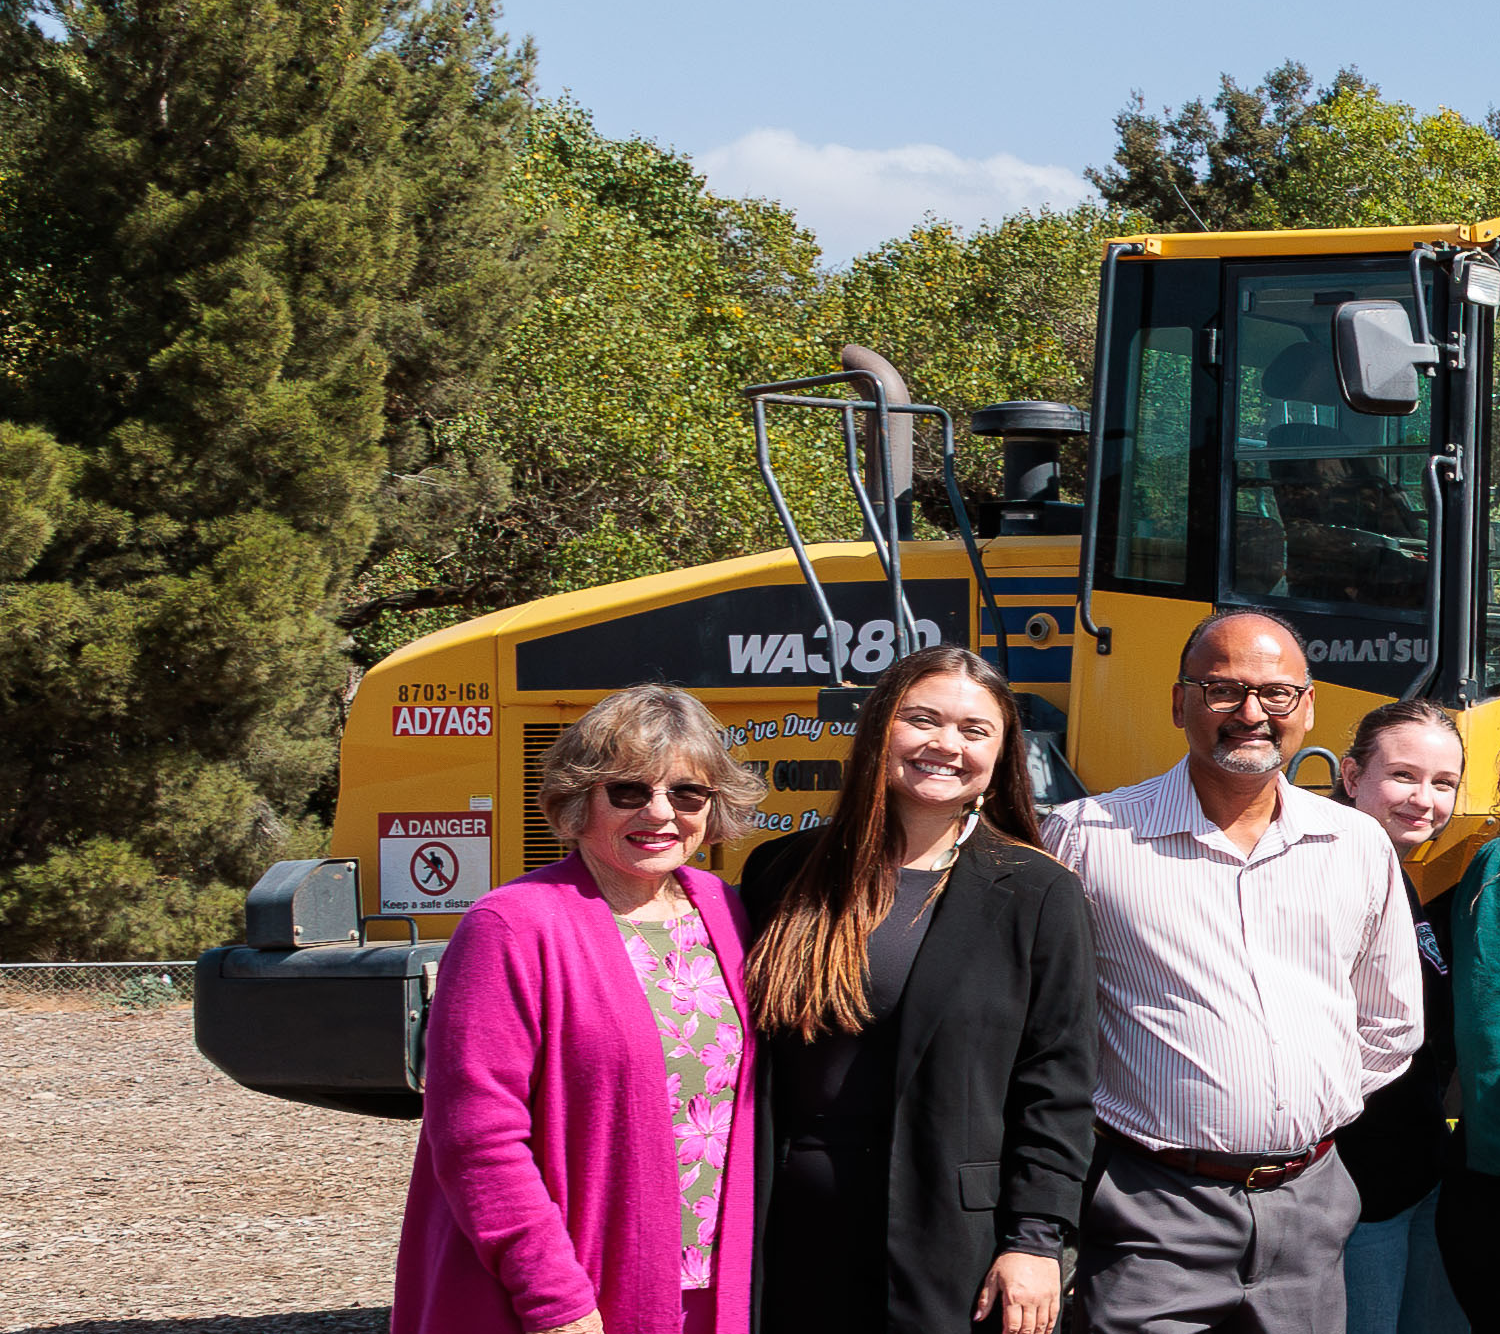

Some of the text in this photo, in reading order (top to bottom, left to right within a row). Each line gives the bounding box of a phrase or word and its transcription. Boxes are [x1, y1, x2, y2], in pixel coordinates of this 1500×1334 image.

[1303, 632, 1429, 663] OMATSU
[398, 682, 490, 702] 8703-168
[395, 707, 492, 735] AD7A65
[783, 714, 825, 741] Dug
[408, 819, 487, 835] DANGER
[383, 899, 408, 911] Keep
[412, 900, 417, 908] a
[420, 899, 442, 909] safe
